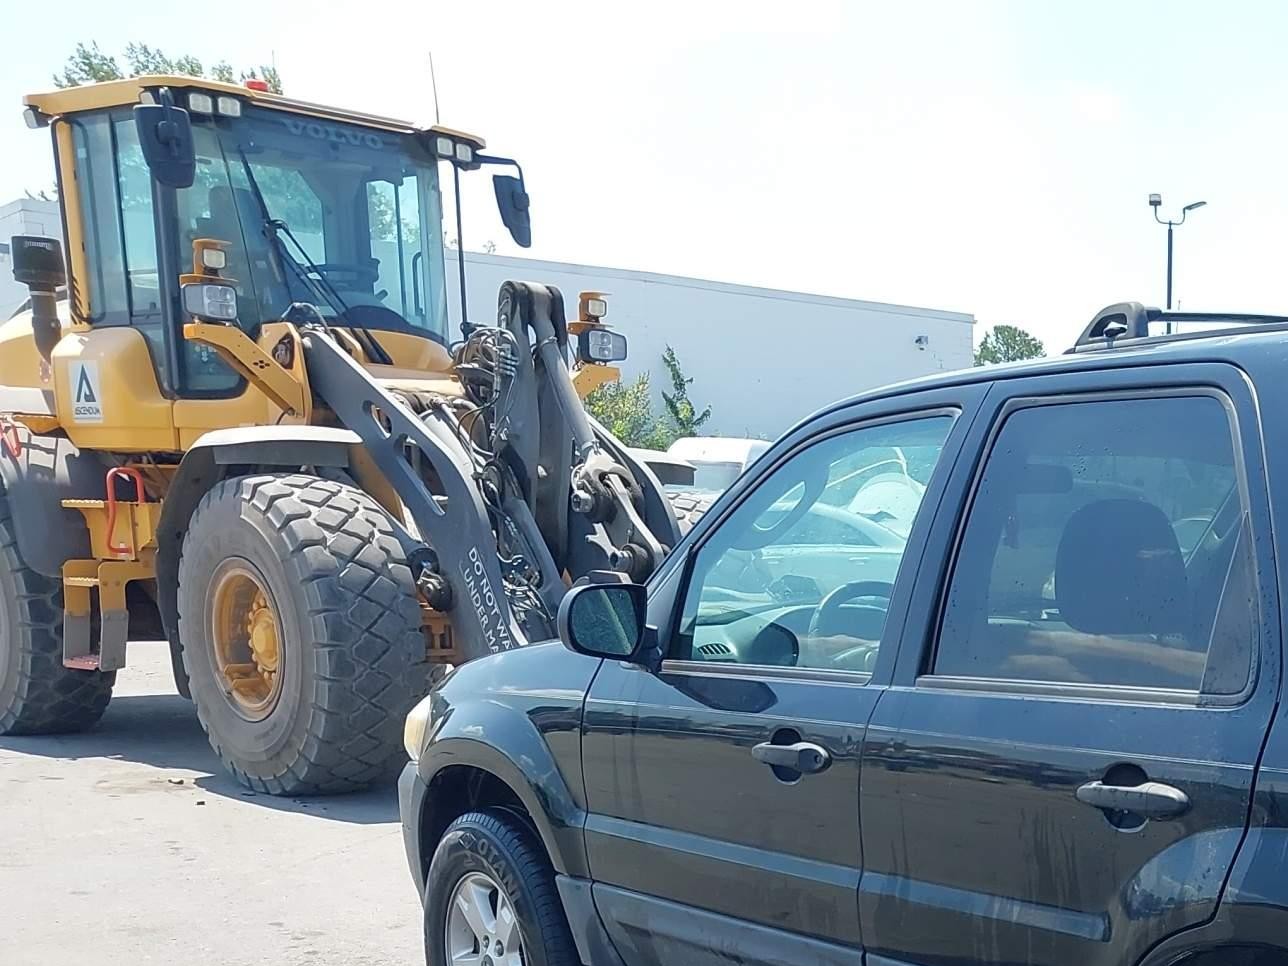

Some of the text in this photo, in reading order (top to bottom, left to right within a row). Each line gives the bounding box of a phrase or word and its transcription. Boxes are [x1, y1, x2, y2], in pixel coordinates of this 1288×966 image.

[282, 119, 384, 149] VOLVO
[464, 567, 489, 630] UNDER
[468, 546, 483, 575] DO
[479, 578, 500, 616] NOT
[477, 838, 521, 902] OTANI
